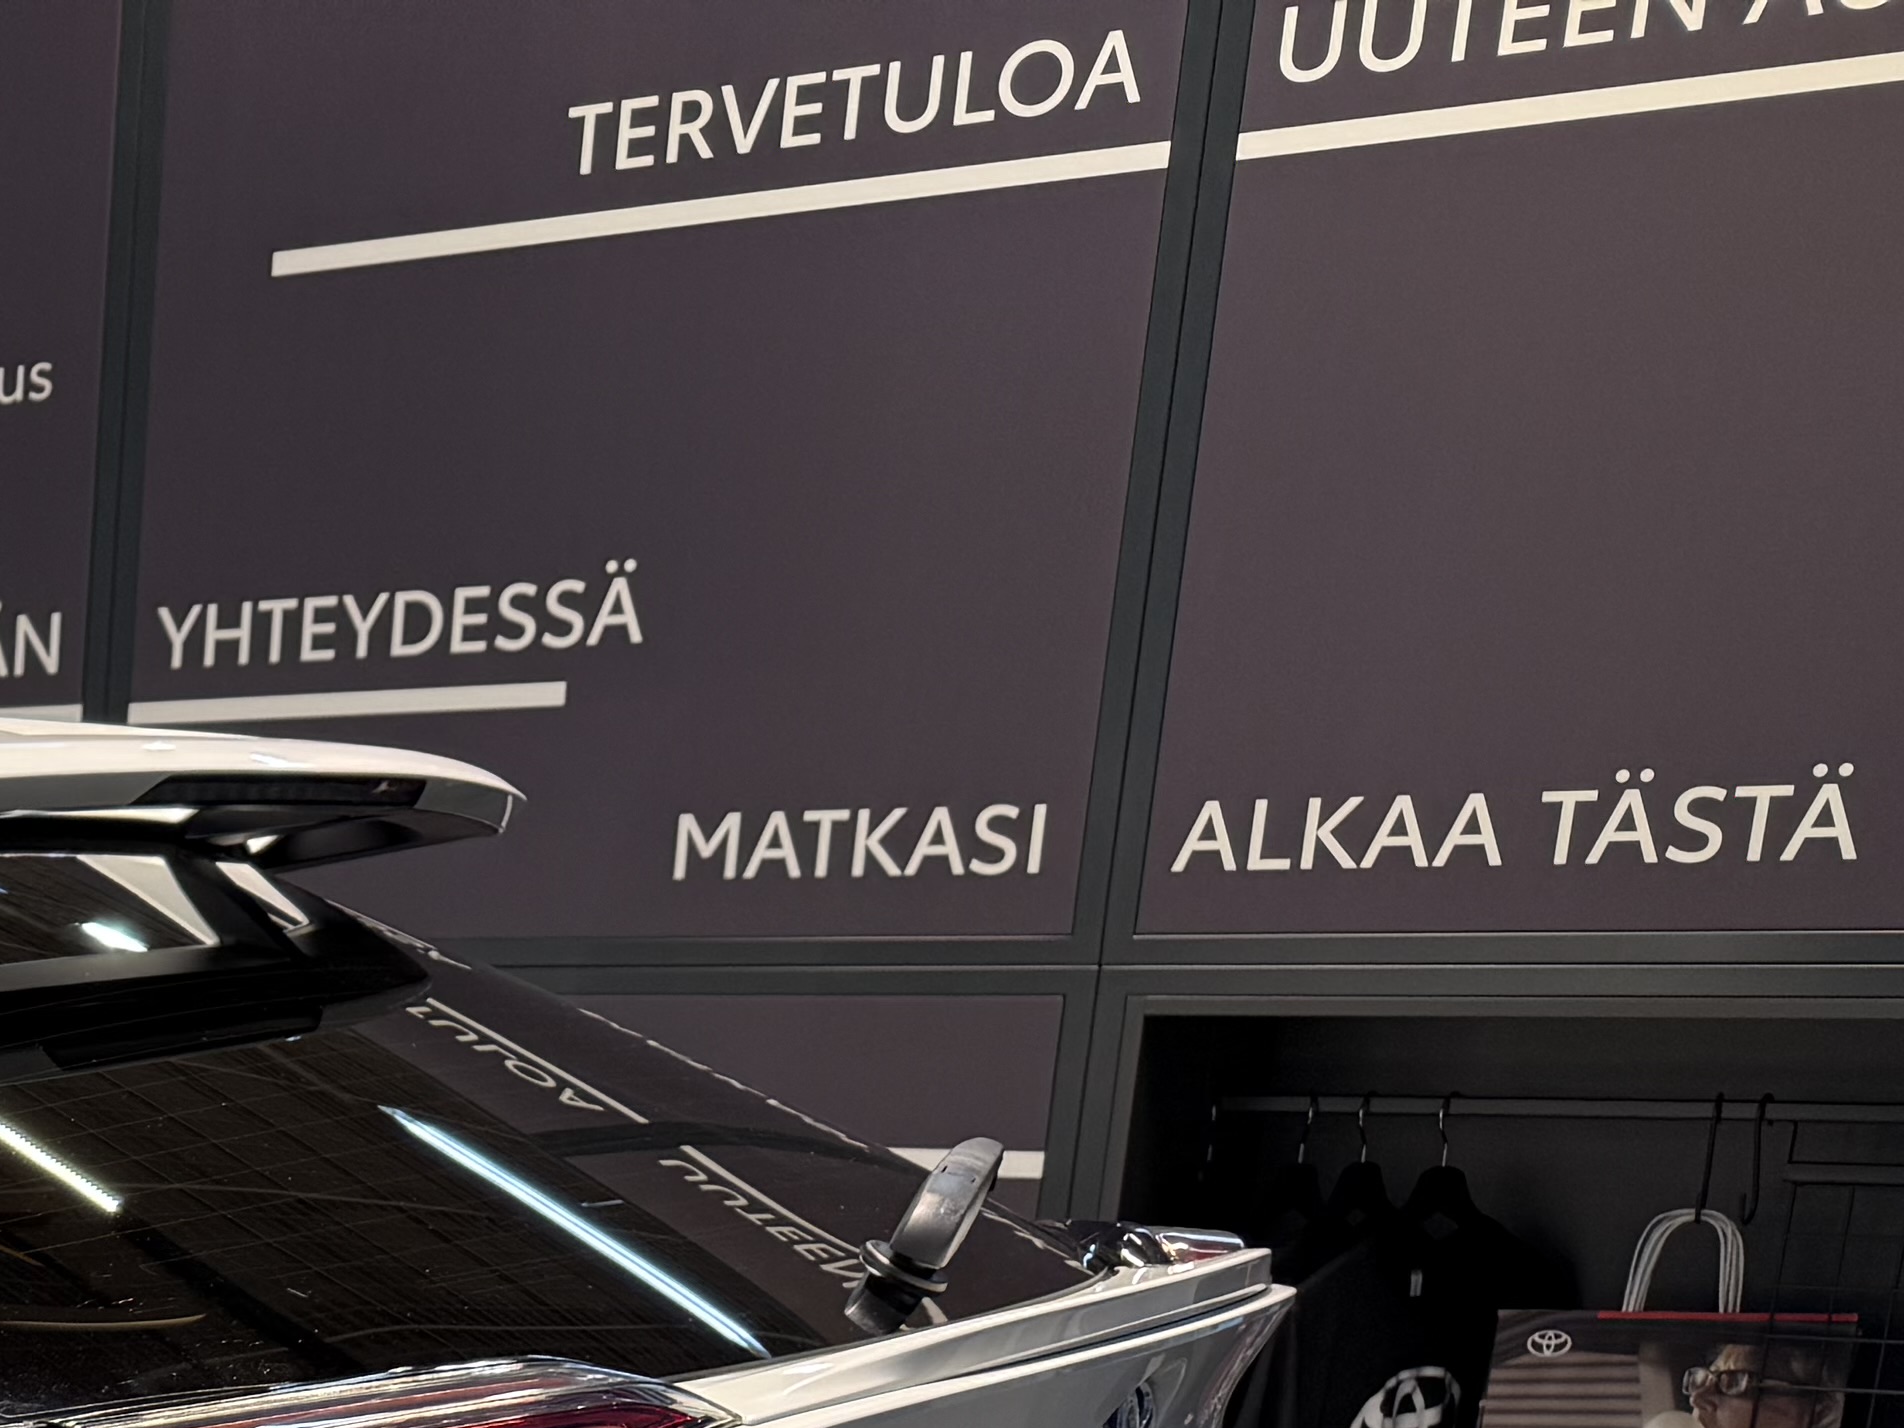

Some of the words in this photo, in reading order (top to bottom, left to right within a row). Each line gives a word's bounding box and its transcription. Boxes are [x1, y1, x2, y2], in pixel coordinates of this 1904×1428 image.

[569, 30, 1141, 175] TERVETULOA
[158, 558, 643, 669] YHTEYDESSÄ
[673, 803, 1048, 881] MATKASI
[1170, 792, 1502, 873] ALKAA
[1541, 762, 1858, 866] TÄSTÄ
